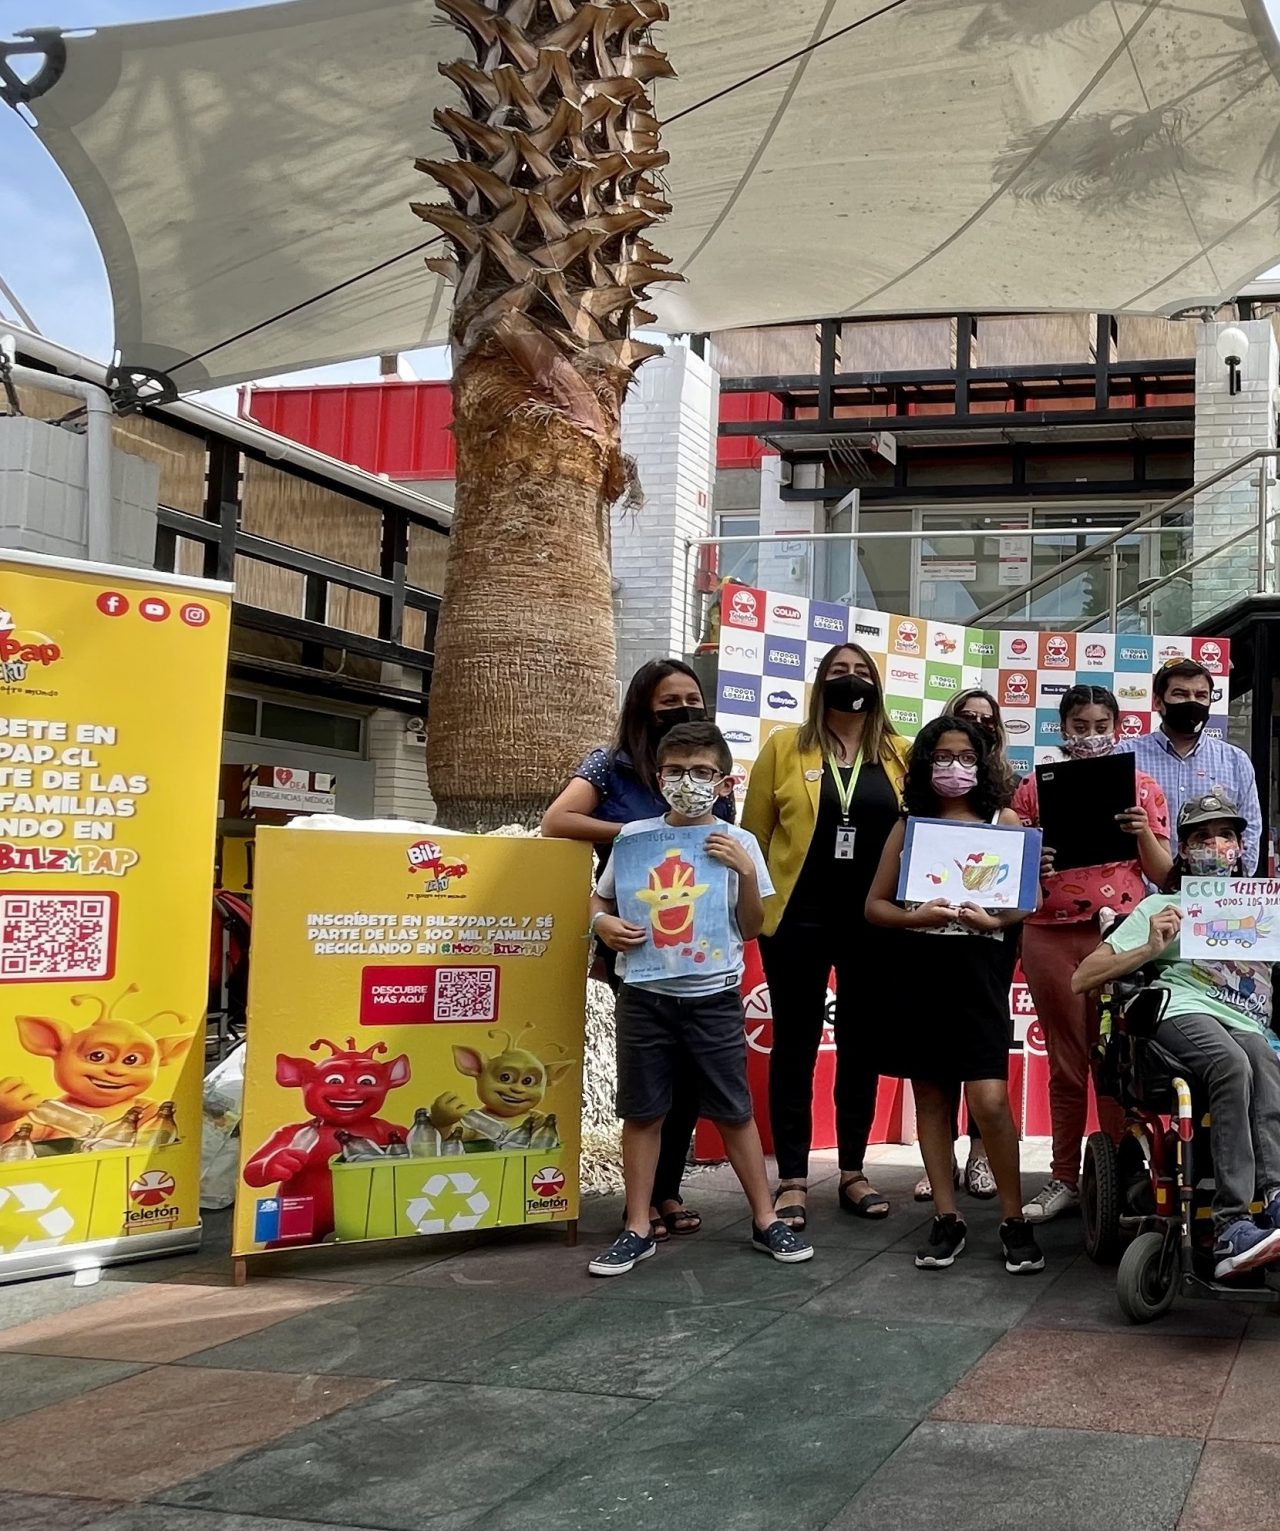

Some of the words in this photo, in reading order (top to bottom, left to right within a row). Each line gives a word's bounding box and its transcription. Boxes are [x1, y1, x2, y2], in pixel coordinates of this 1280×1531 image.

[724, 645, 758, 659] enel
[76, 724, 116, 745] EN
[0, 743, 98, 767] PAP.CL
[42, 770, 80, 790] DE
[90, 773, 148, 794] LAS
[289, 781, 307, 790] DEA
[251, 789, 302, 802] EMERGENCIAS
[0, 793, 136, 817] FAMILIAS
[0, 818, 64, 838] NDO
[74, 821, 113, 840] EN
[407, 844, 443, 866] Bilz
[1186, 881, 1226, 898] CCU
[1215, 898, 1243, 908] TODOS
[1247, 897, 1262, 906] LOS
[307, 911, 398, 926] INSCRÍBETE
[401, 914, 423, 927] EN
[426, 915, 518, 928] BILZYPAP.CL
[521, 916, 532, 928] Y
[536, 914, 554, 928] SÉ
[308, 928, 360, 940] PARTE
[364, 928, 385, 940] DE
[388, 928, 419, 940] LAS
[423, 928, 454, 940] 100
[458, 929, 483, 941] MIL
[487, 929, 552, 941] FAMILIAS
[314, 942, 413, 954] RECICLANDO
[416, 942, 437, 954] EN
[371, 985, 429, 995] DESCUBRE
[373, 994, 398, 1004] MÁS
[398, 994, 426, 1003] AQUÍ
[123, 1204, 180, 1222] Teletón
